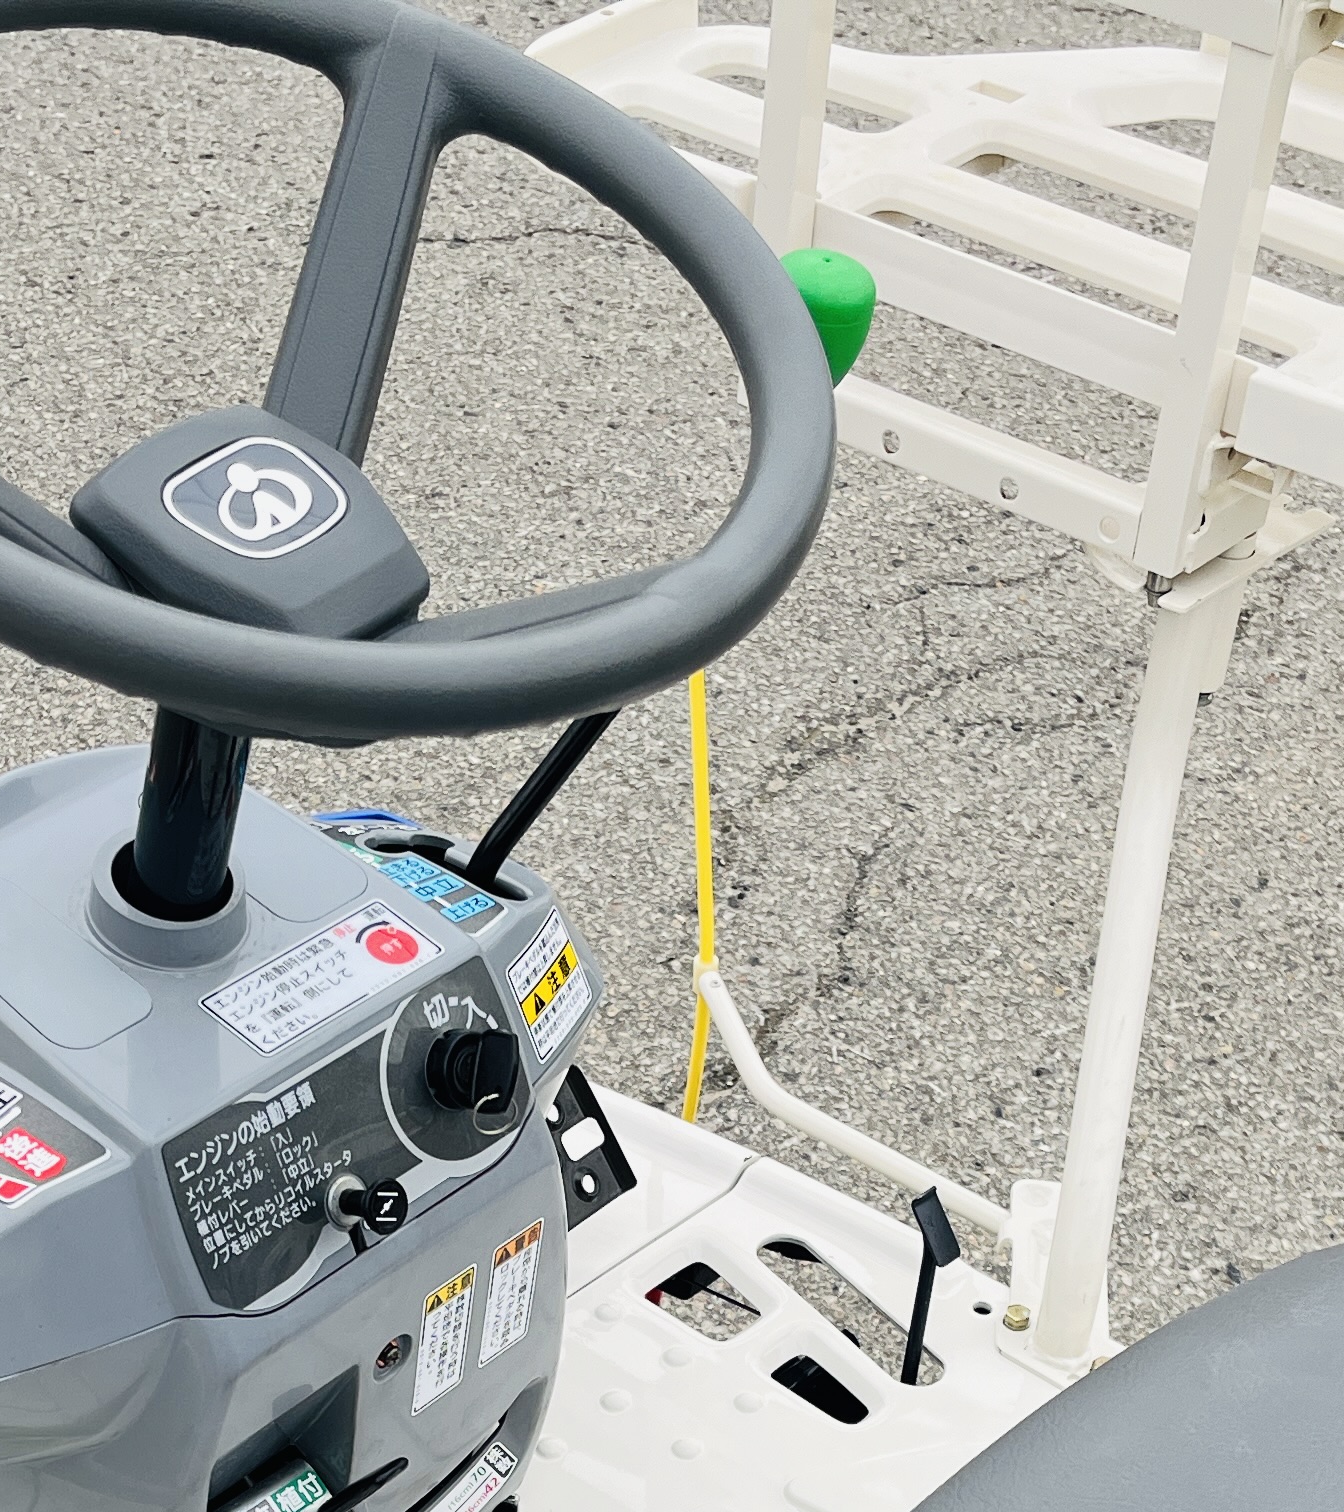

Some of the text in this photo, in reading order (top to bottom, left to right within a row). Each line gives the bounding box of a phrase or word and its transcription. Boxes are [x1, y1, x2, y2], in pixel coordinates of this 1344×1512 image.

[415, 879, 459, 896] 中立
[448, 897, 489, 920] 上げる
[213, 938, 335, 1010] エンジン始動時は緊急
[230, 950, 348, 1023] エンジン停止スイッチ
[262, 1013, 320, 1045] ください。
[422, 992, 450, 1030] 切
[460, 995, 488, 1030] 入
[174, 1081, 317, 1184] エンジンの始動要領
[275, 1131, 319, 1168] 「ロック」
[196, 1198, 250, 1237] 植付レバー
[281, 1154, 316, 1185] 「中立」
[202, 1150, 353, 1254] 位置にしてからリコイルスタータ
[212, 1196, 317, 1270] ノブを引いてください。
